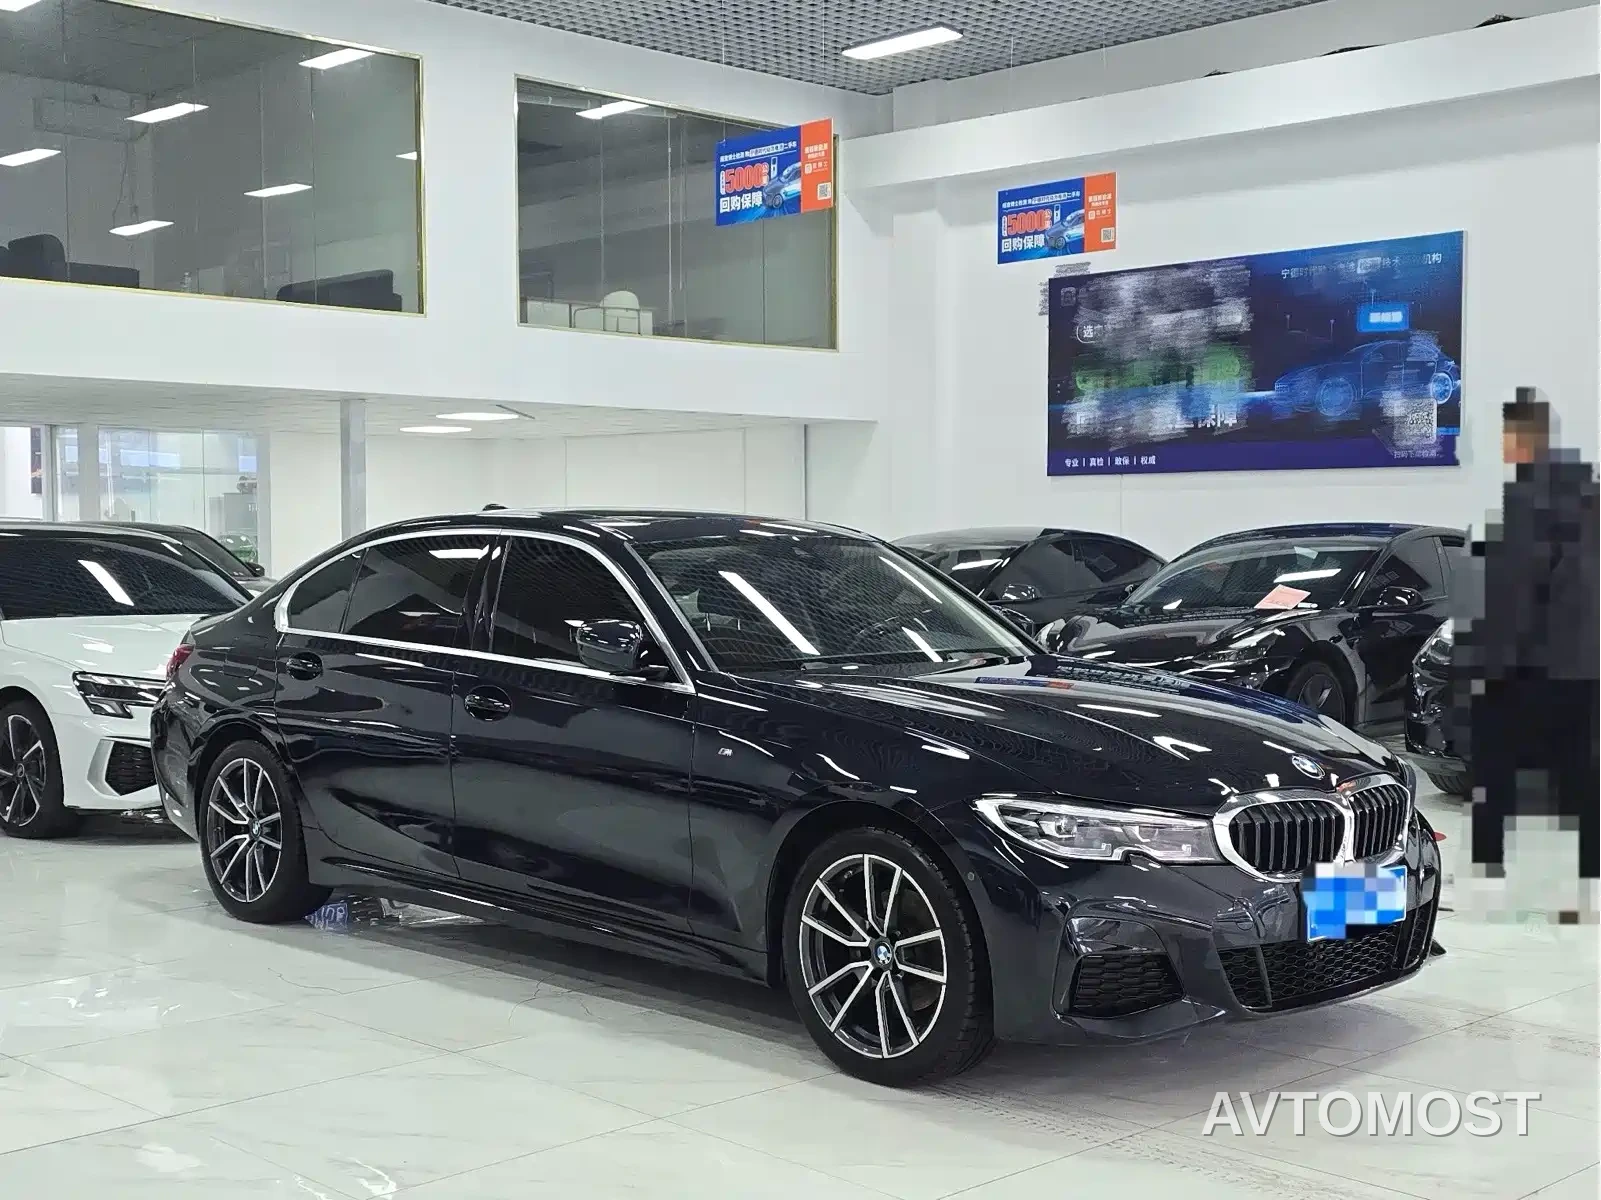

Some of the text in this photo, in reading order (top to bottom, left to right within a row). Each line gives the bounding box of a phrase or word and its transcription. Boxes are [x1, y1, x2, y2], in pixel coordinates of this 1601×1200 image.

[724, 163, 762, 193] 5000
[720, 190, 763, 214] 回购保障
[1007, 209, 1045, 235] 5000
[1002, 233, 1045, 253] 回购保障
[1064, 458, 1079, 468] 专业
[1140, 455, 1156, 465] 权威
